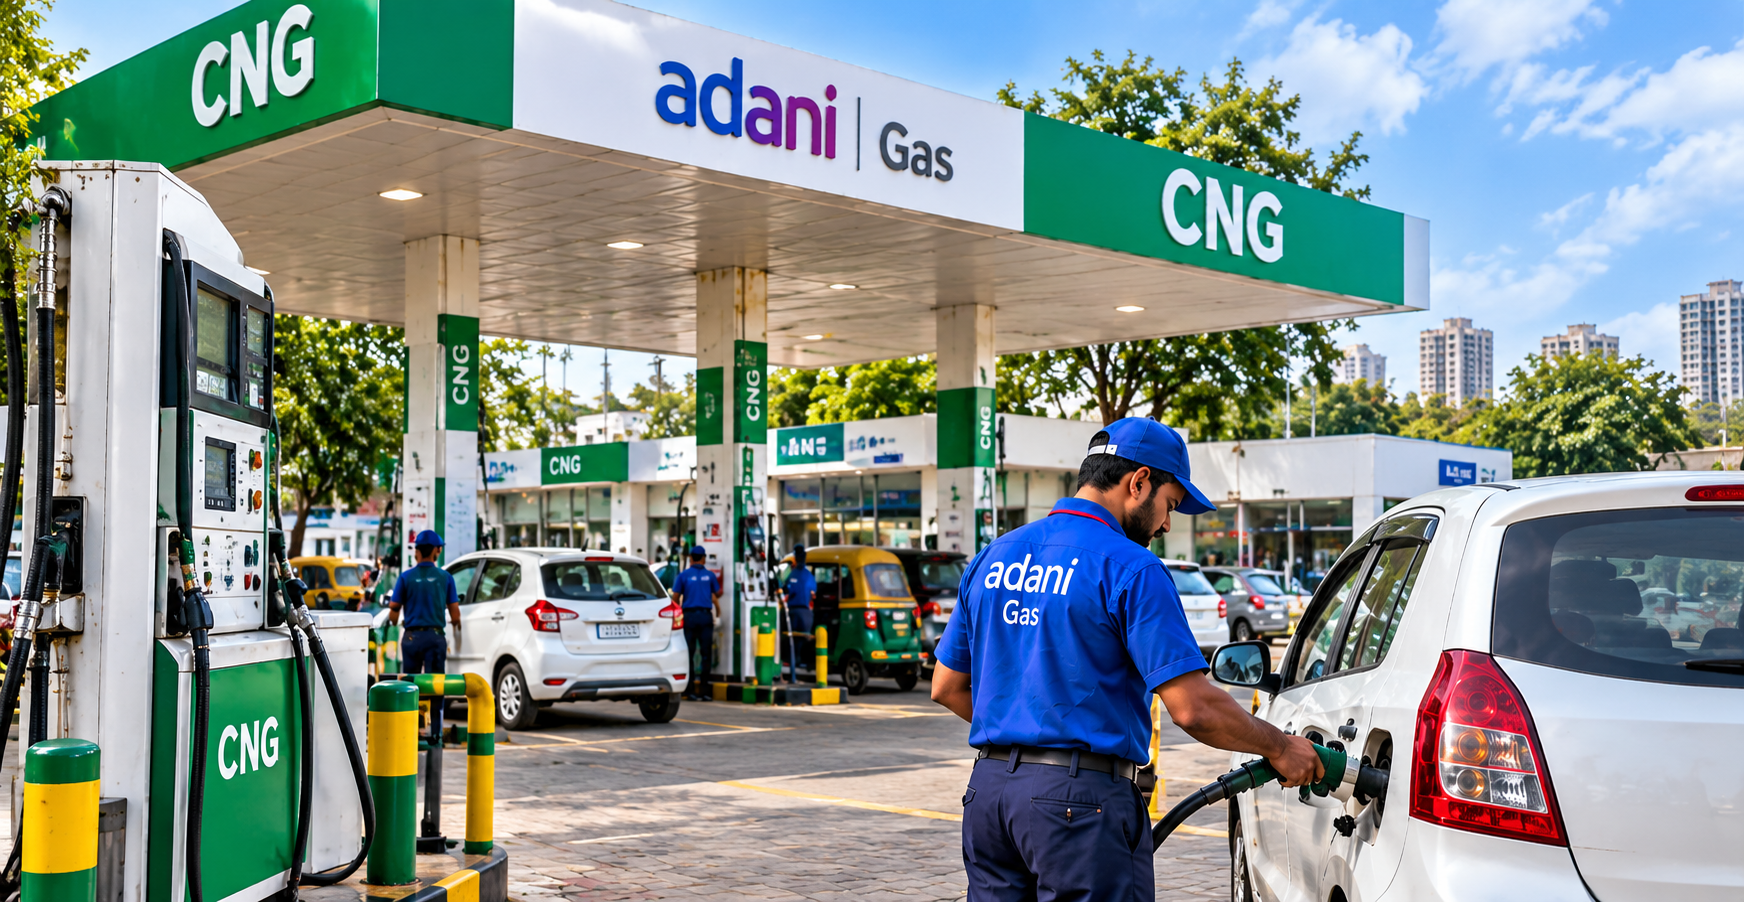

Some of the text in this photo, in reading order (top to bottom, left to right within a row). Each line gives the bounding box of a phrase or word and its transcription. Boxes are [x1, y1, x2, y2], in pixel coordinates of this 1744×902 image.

[191, 4, 315, 128] CNG
[655, 57, 954, 183] adani Gas
[1161, 167, 1284, 264] CNG
[452, 344, 470, 405] CNG
[746, 369, 761, 422] CNG
[979, 405, 992, 450] CNG
[549, 454, 581, 476] CNG
[984, 553, 1079, 596] adani
[1002, 599, 1039, 627] Gas
[218, 715, 279, 780] CNG
